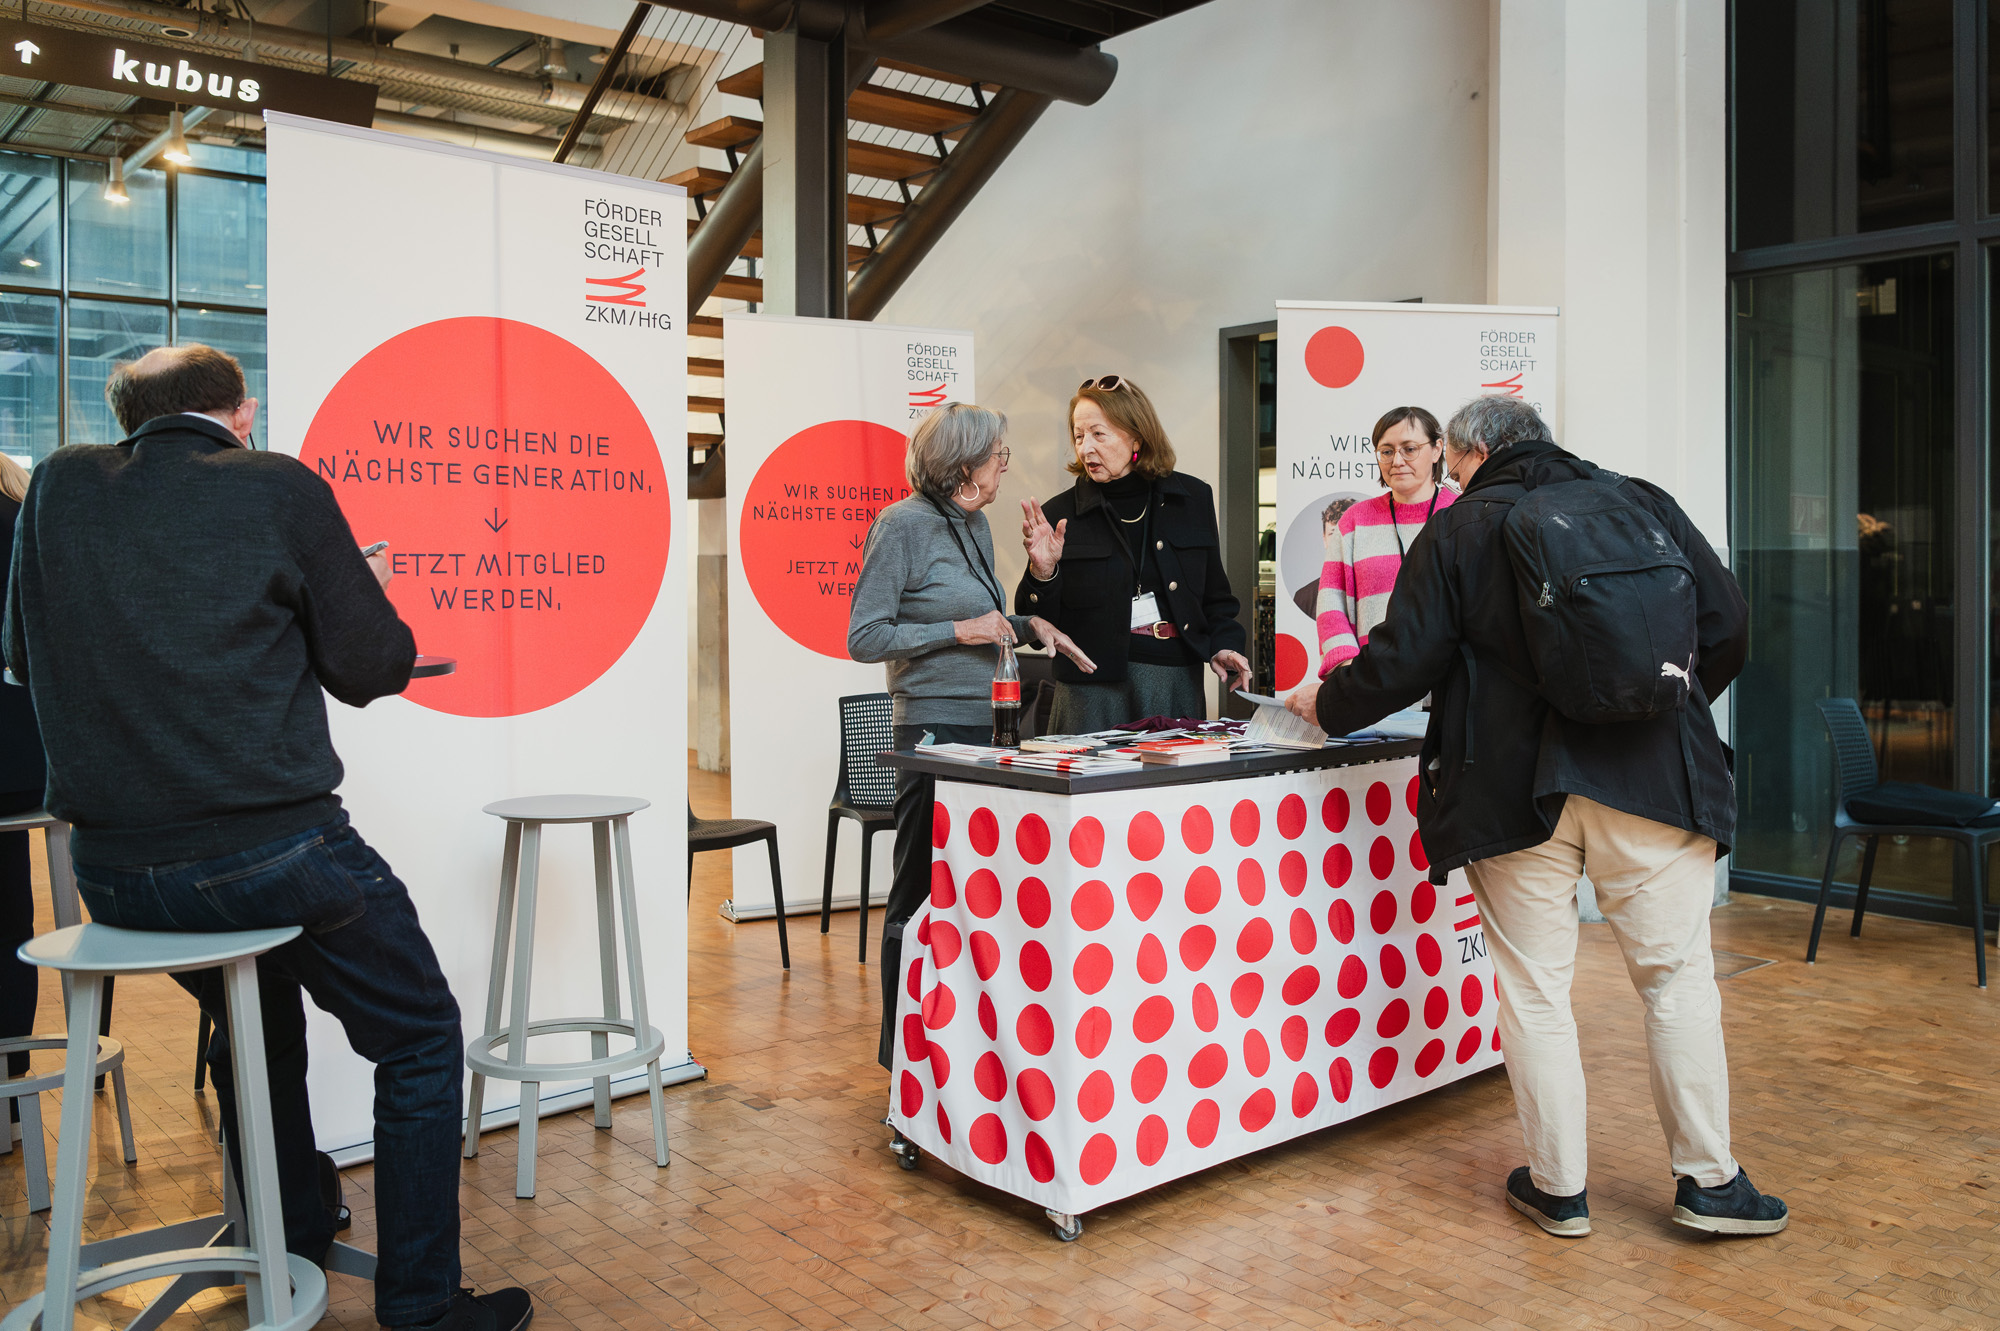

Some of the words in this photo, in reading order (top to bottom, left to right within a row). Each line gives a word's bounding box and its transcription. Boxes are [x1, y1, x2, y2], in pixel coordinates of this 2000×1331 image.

[112, 48, 261, 102] kubus
[584, 198, 662, 227] FÖRDER
[584, 220, 657, 247] GESELL
[584, 241, 664, 268] SCHAFT
[585, 304, 671, 330] ZKM/HfG
[1480, 329, 1536, 344] FÖRDER
[907, 342, 957, 357] FÖRDER
[1480, 345, 1532, 358] GESELL
[907, 356, 954, 370] GESELL
[1480, 359, 1537, 371] SCHAFT
[907, 369, 959, 383] SCHAFT
[373, 420, 433, 449] WIR
[448, 425, 557, 455] SUCHEN
[570, 433, 610, 457] DIE
[1330, 434, 1371, 454] WIR
[318, 449, 462, 485] NÄCHSTE
[1292, 456, 1379, 480] NÄCHST
[784, 483, 819, 500] WIR
[827, 485, 893, 502] SUCHEN
[753, 501, 836, 521] NÄCHSTE
[392, 553, 466, 577] ETZT
[475, 551, 606, 577] MITGLIED
[786, 559, 839, 575] JETZT
